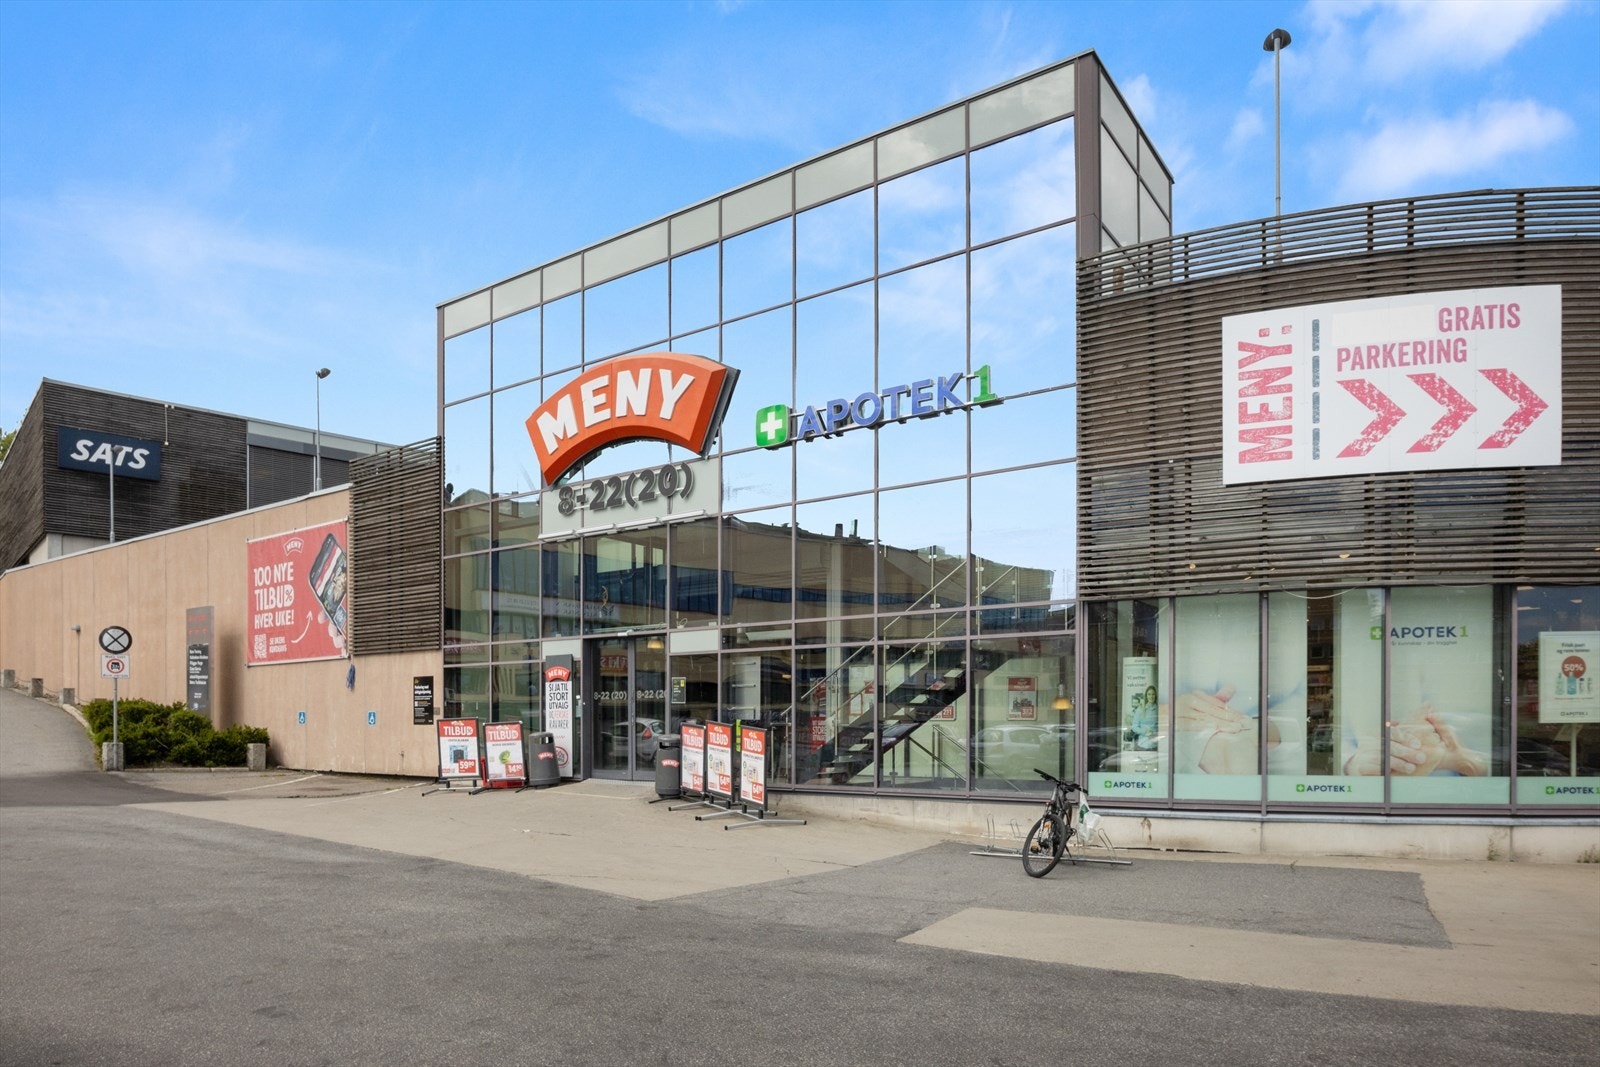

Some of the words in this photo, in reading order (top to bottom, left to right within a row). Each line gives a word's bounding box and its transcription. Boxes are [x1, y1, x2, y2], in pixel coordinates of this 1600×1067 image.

[1438, 303, 1521, 333] GRATIS
[1337, 337, 1467, 372] PARKERING
[1238, 324, 1293, 464] MENY:
[796, 372, 966, 440] APOTEK
[973, 364, 998, 403] 1
[536, 368, 695, 455] MENY
[70, 439, 150, 469] SATS
[558, 462, 695, 516] 8-22(20)
[286, 541, 302, 553] MENY
[254, 565, 271, 587] 100
[274, 561, 294, 583] NYE
[254, 584, 295, 611] TILBUD
[254, 612, 274, 630] HVER
[275, 610, 294, 627] UKE!
[1391, 626, 1457, 638] APOTEK
[1459, 625, 1469, 638] 1
[547, 668, 567, 679] MENY
[1564, 663, 1584, 672] 50%
[549, 683, 554, 692] SI
[554, 683, 560, 692] JA
[549, 692, 568, 701] STORT
[593, 691, 610, 700] 8-22
[611, 691, 627, 700] (20)
[636, 690, 654, 699] 8-22
[549, 701, 568, 709] UTVALG
[443, 726, 474, 736] TILBUD
[488, 730, 519, 741] TILBUD
[683, 734, 704, 747] TILBUD
[709, 732, 729, 746] TILBUD
[743, 737, 763, 752] TILBUD
[1113, 781, 1147, 789] APOTEK
[1306, 785, 1345, 793] APOTEK
[1346, 785, 1352, 793] 1
